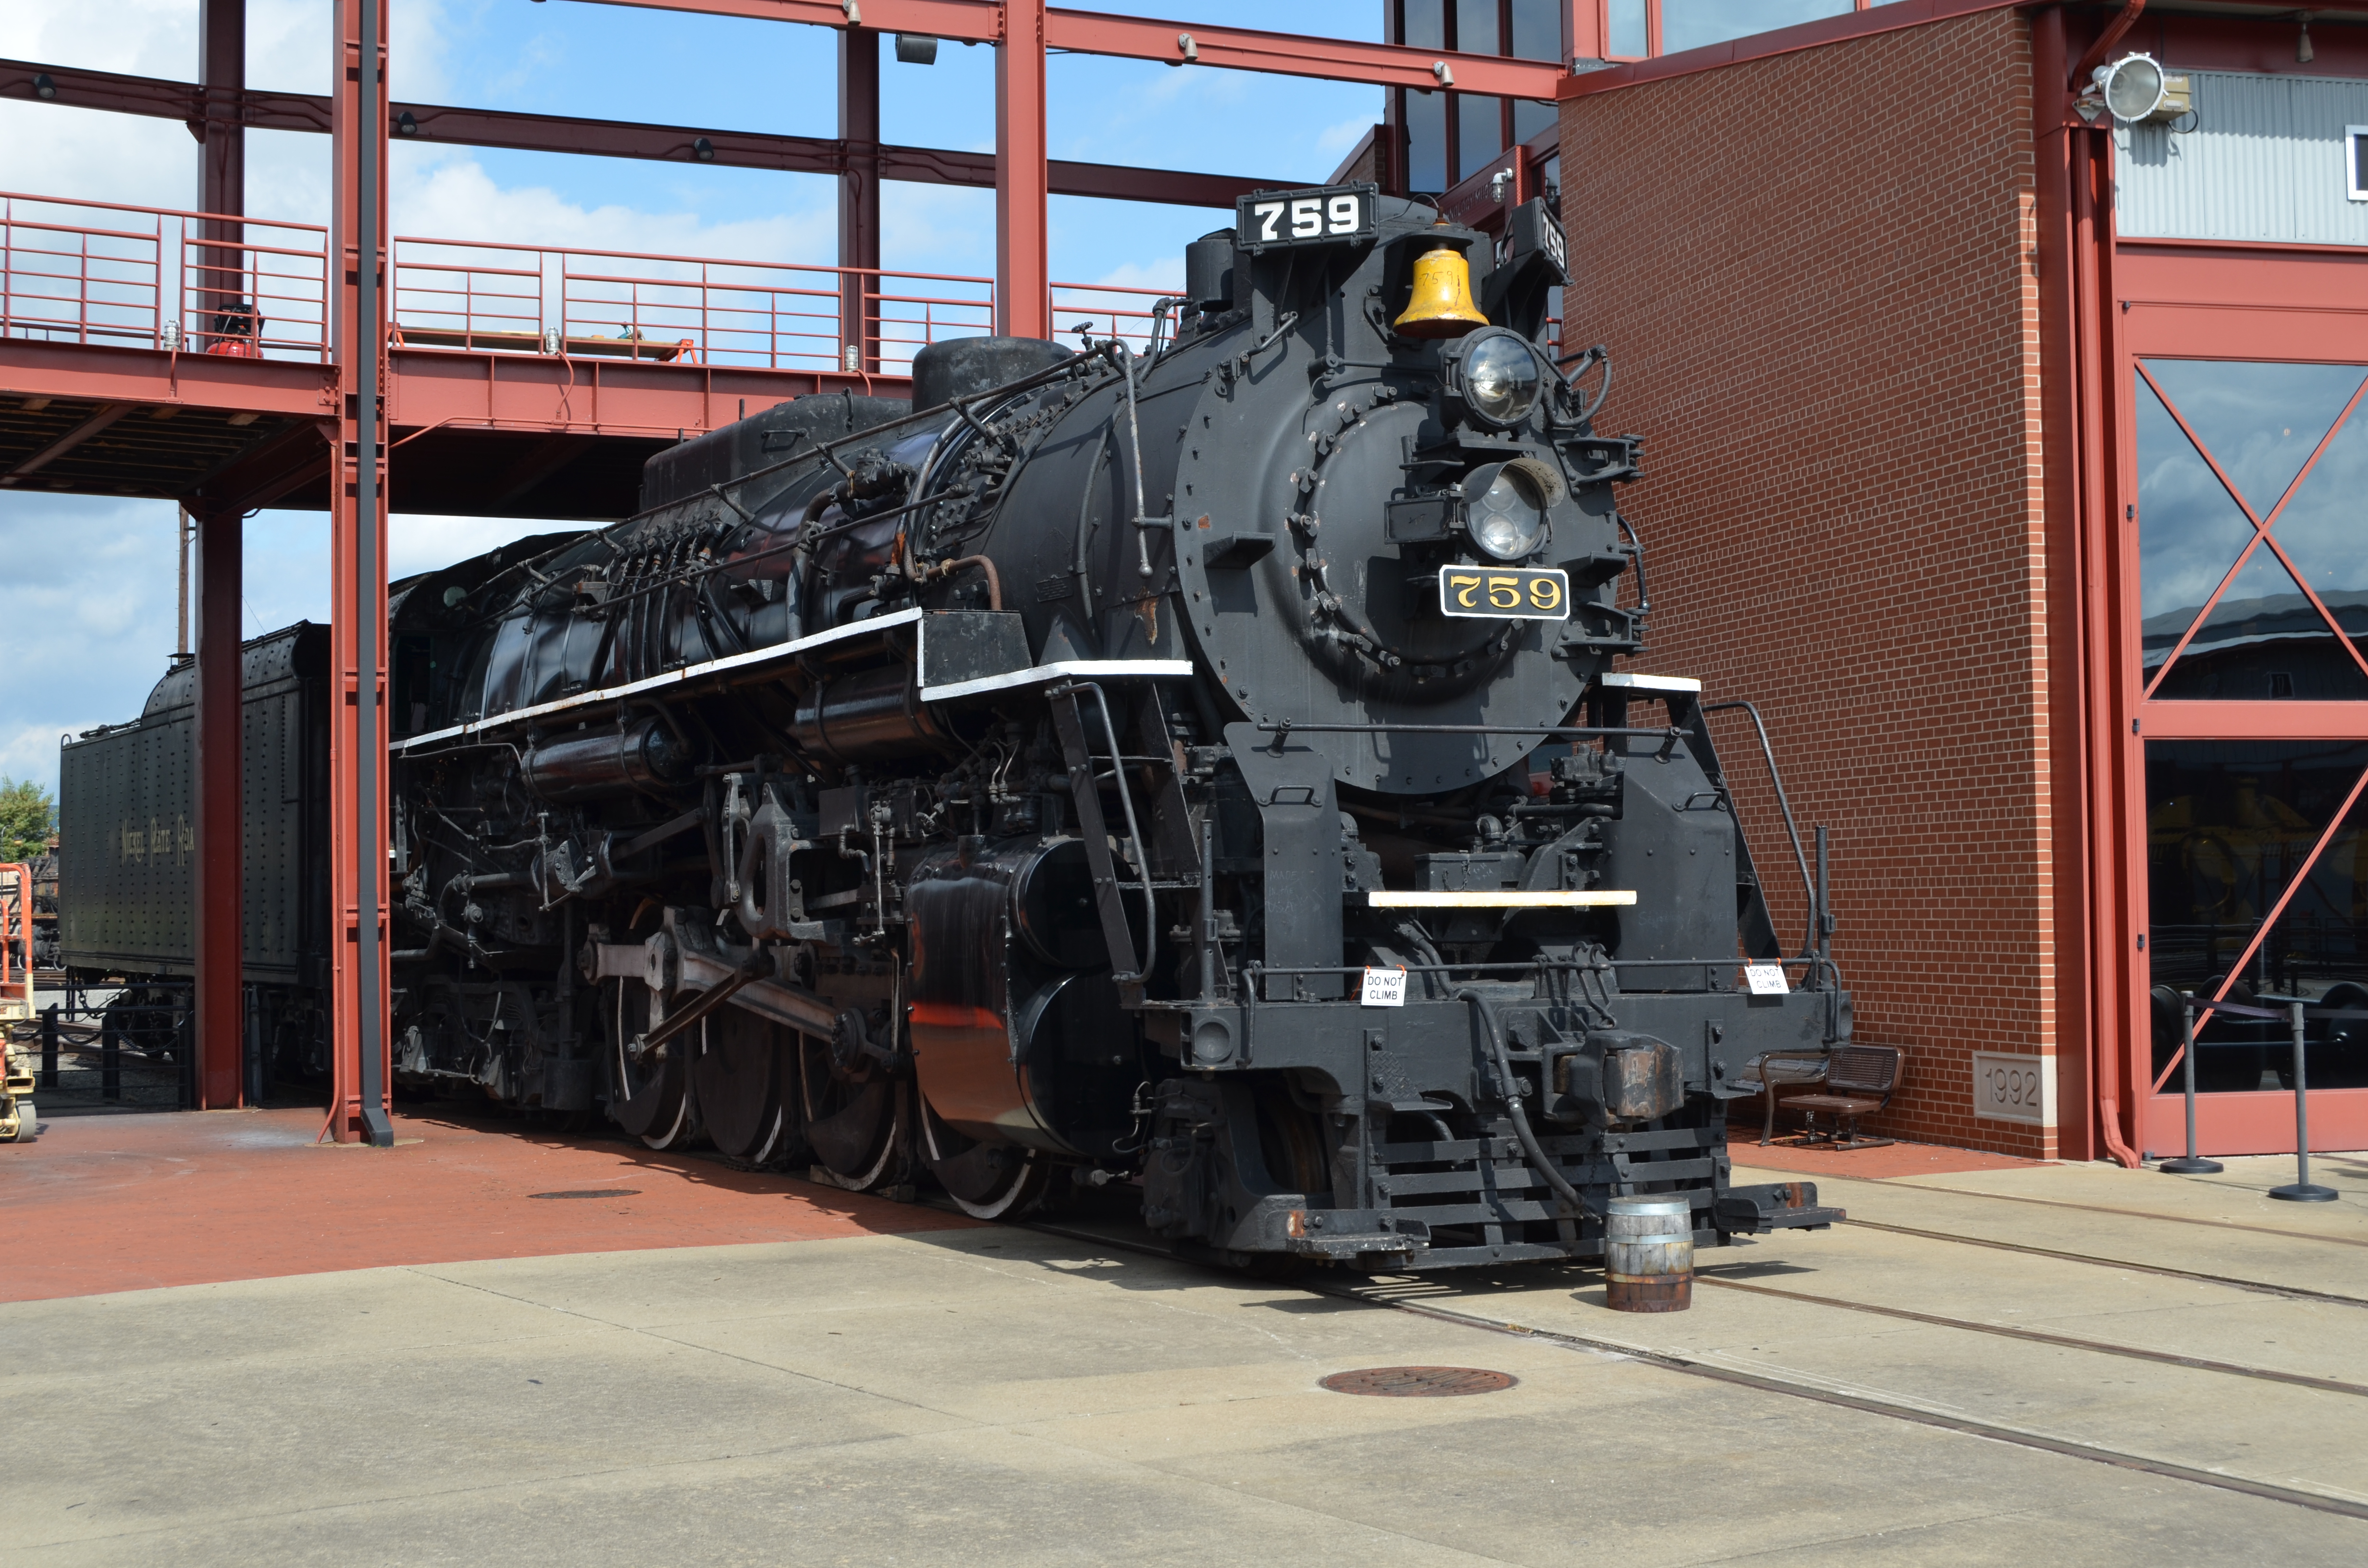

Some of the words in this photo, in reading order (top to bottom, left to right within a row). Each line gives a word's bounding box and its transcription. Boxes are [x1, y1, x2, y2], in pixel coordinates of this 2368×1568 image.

[1255, 195, 1358, 241] 759
[1542, 212, 1565, 269] 759
[1421, 270, 1453, 286] 759
[1450, 575, 1561, 610] 759
[177, 813, 195, 867] ROA
[1368, 976, 1381, 985] DO
[1384, 977, 1402, 986] NOT
[1369, 990, 1397, 1000] CLIMB
[1985, 1068, 2037, 1107] 1992
